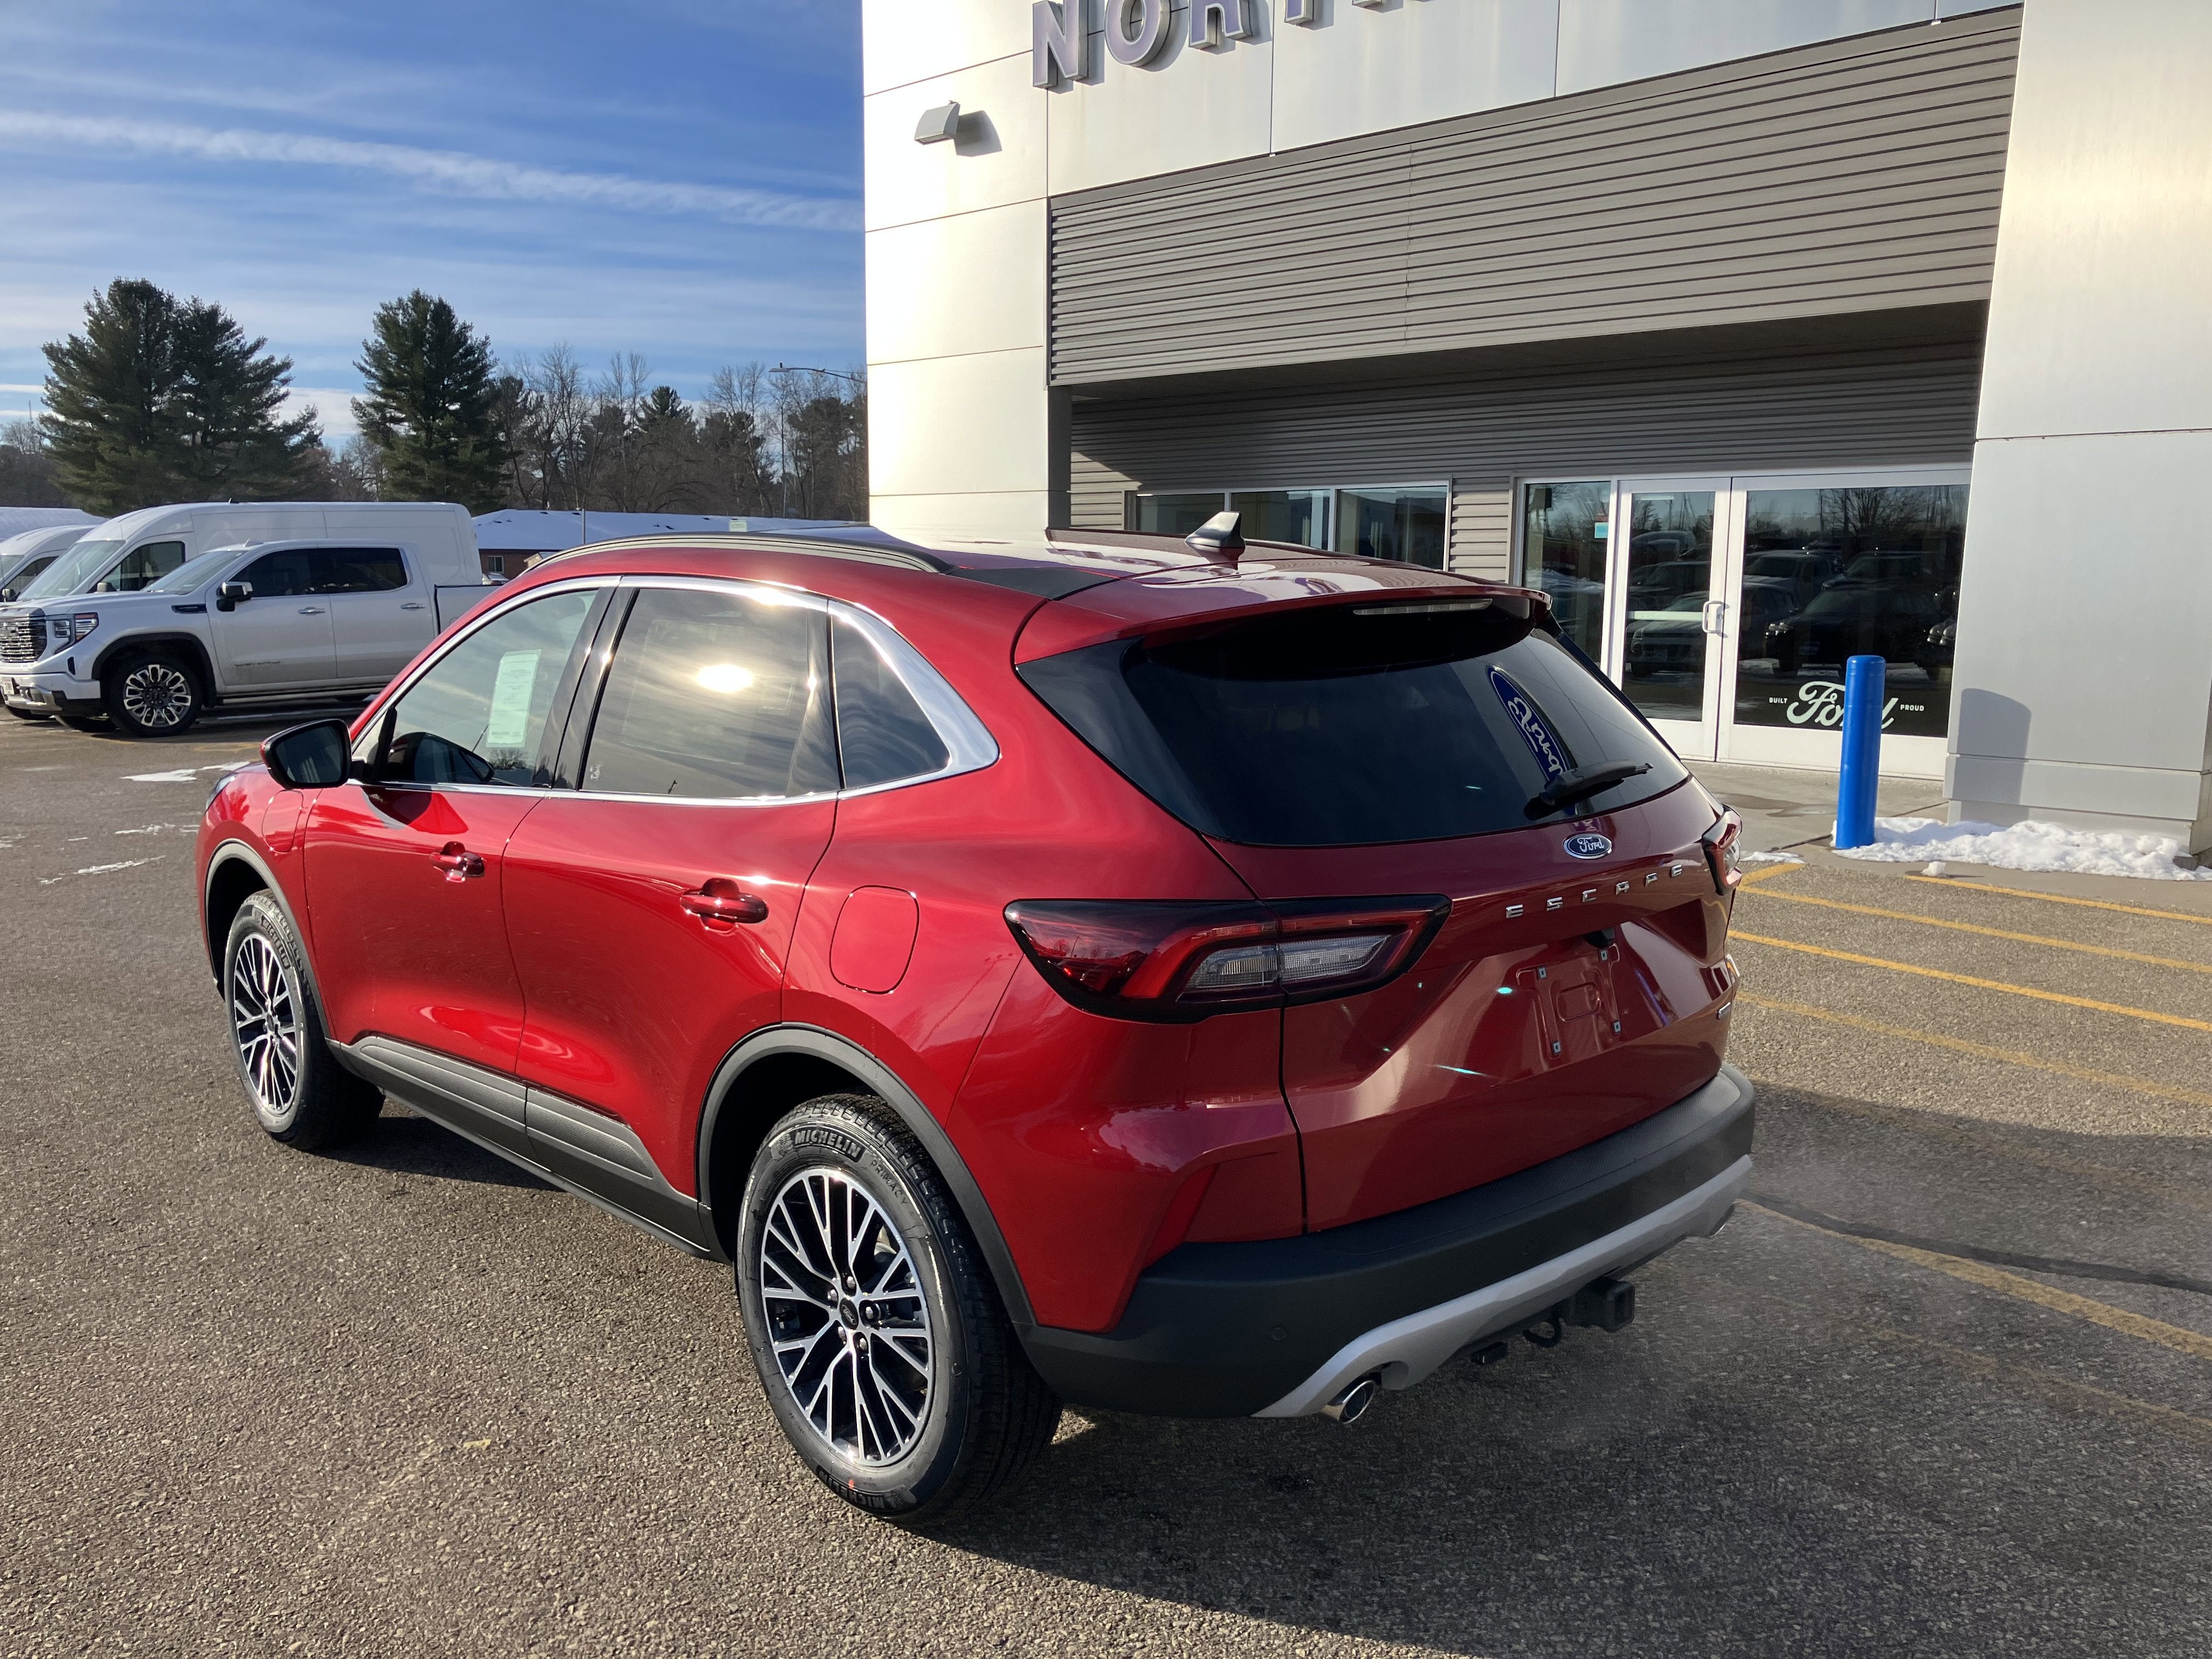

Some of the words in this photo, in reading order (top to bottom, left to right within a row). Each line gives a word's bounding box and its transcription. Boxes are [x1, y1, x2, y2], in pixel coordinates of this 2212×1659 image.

[1786, 681, 1899, 730] Fo
[1577, 836, 1605, 853] Ford
[1505, 864, 1683, 919] ESCAPE
[795, 1130, 861, 1158] MICHELIN
[870, 1159, 909, 1204] PRIMACY
